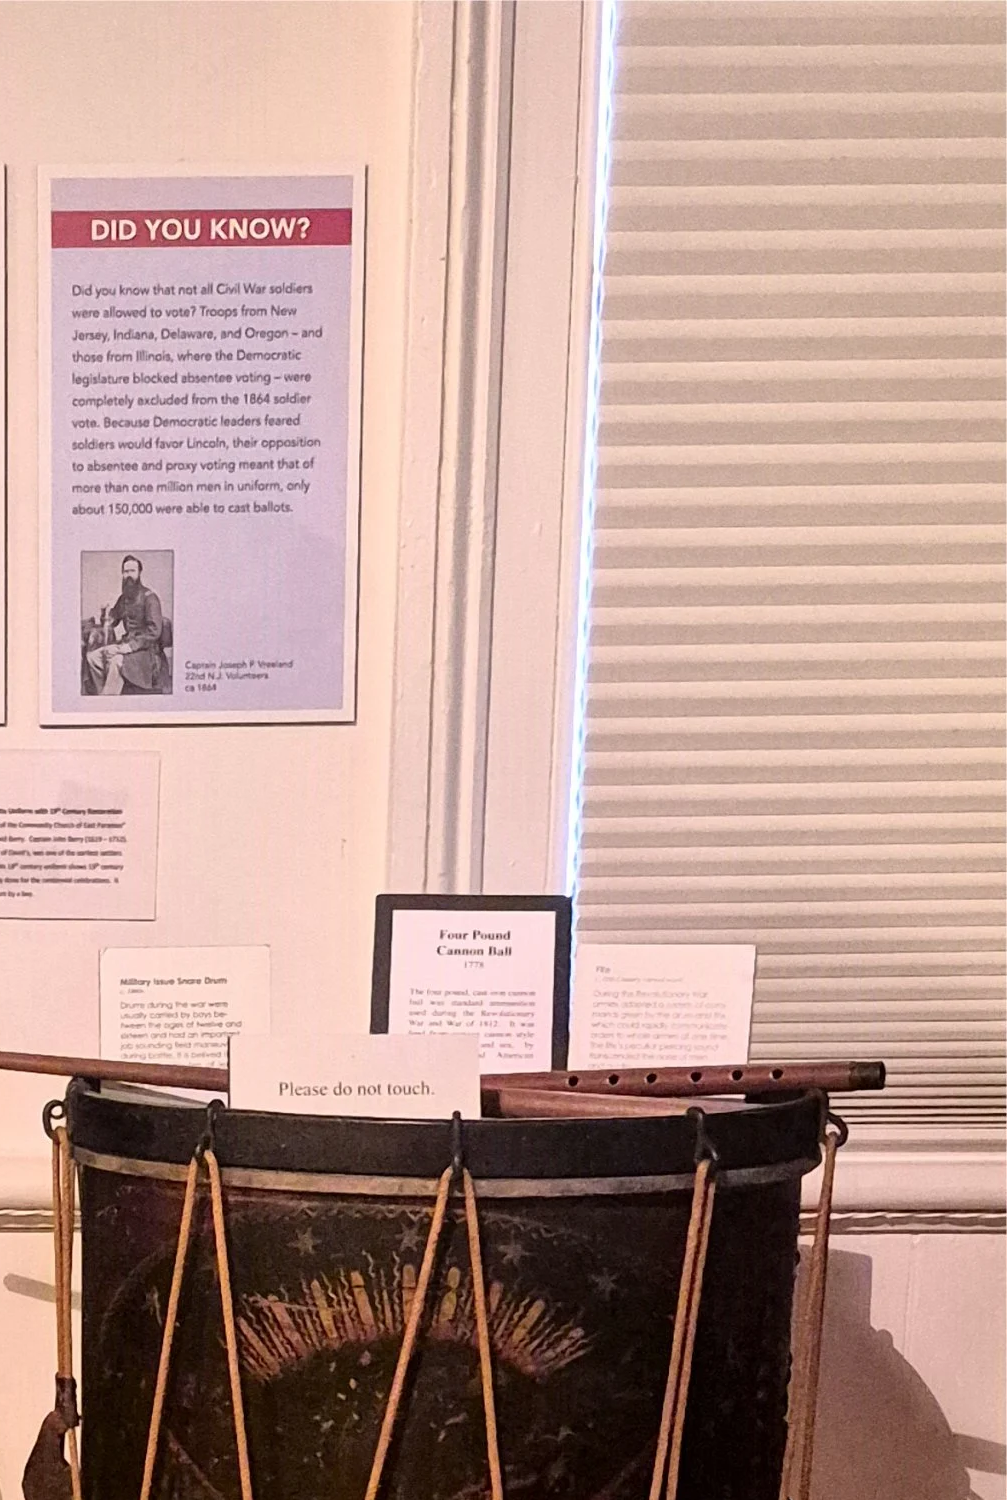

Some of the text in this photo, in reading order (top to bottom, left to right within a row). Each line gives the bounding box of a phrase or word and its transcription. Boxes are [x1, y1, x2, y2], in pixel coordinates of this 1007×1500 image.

[91, 217, 311, 241] DID YOU KNOW?
[71, 282, 313, 299] Did you know that not all Civil War soldiers
[71, 304, 297, 320] were allowed to vote? Troops from New
[71, 349, 302, 363] those from Illinois, where the Democratic
[71, 392, 311, 409] completely excluded from the 1864 soldier
[71, 413, 301, 428] vote. Because Democratic leaders feared
[71, 436, 321, 450] soldiers would favor Lincoln, their opposition
[71, 501, 293, 515] about 150,000 were able to cast ballots.
[439, 930, 510, 940] Four Pound
[435, 946, 512, 956] Cannon Ball
[279, 1081, 435, 1096] Please do not touch.
